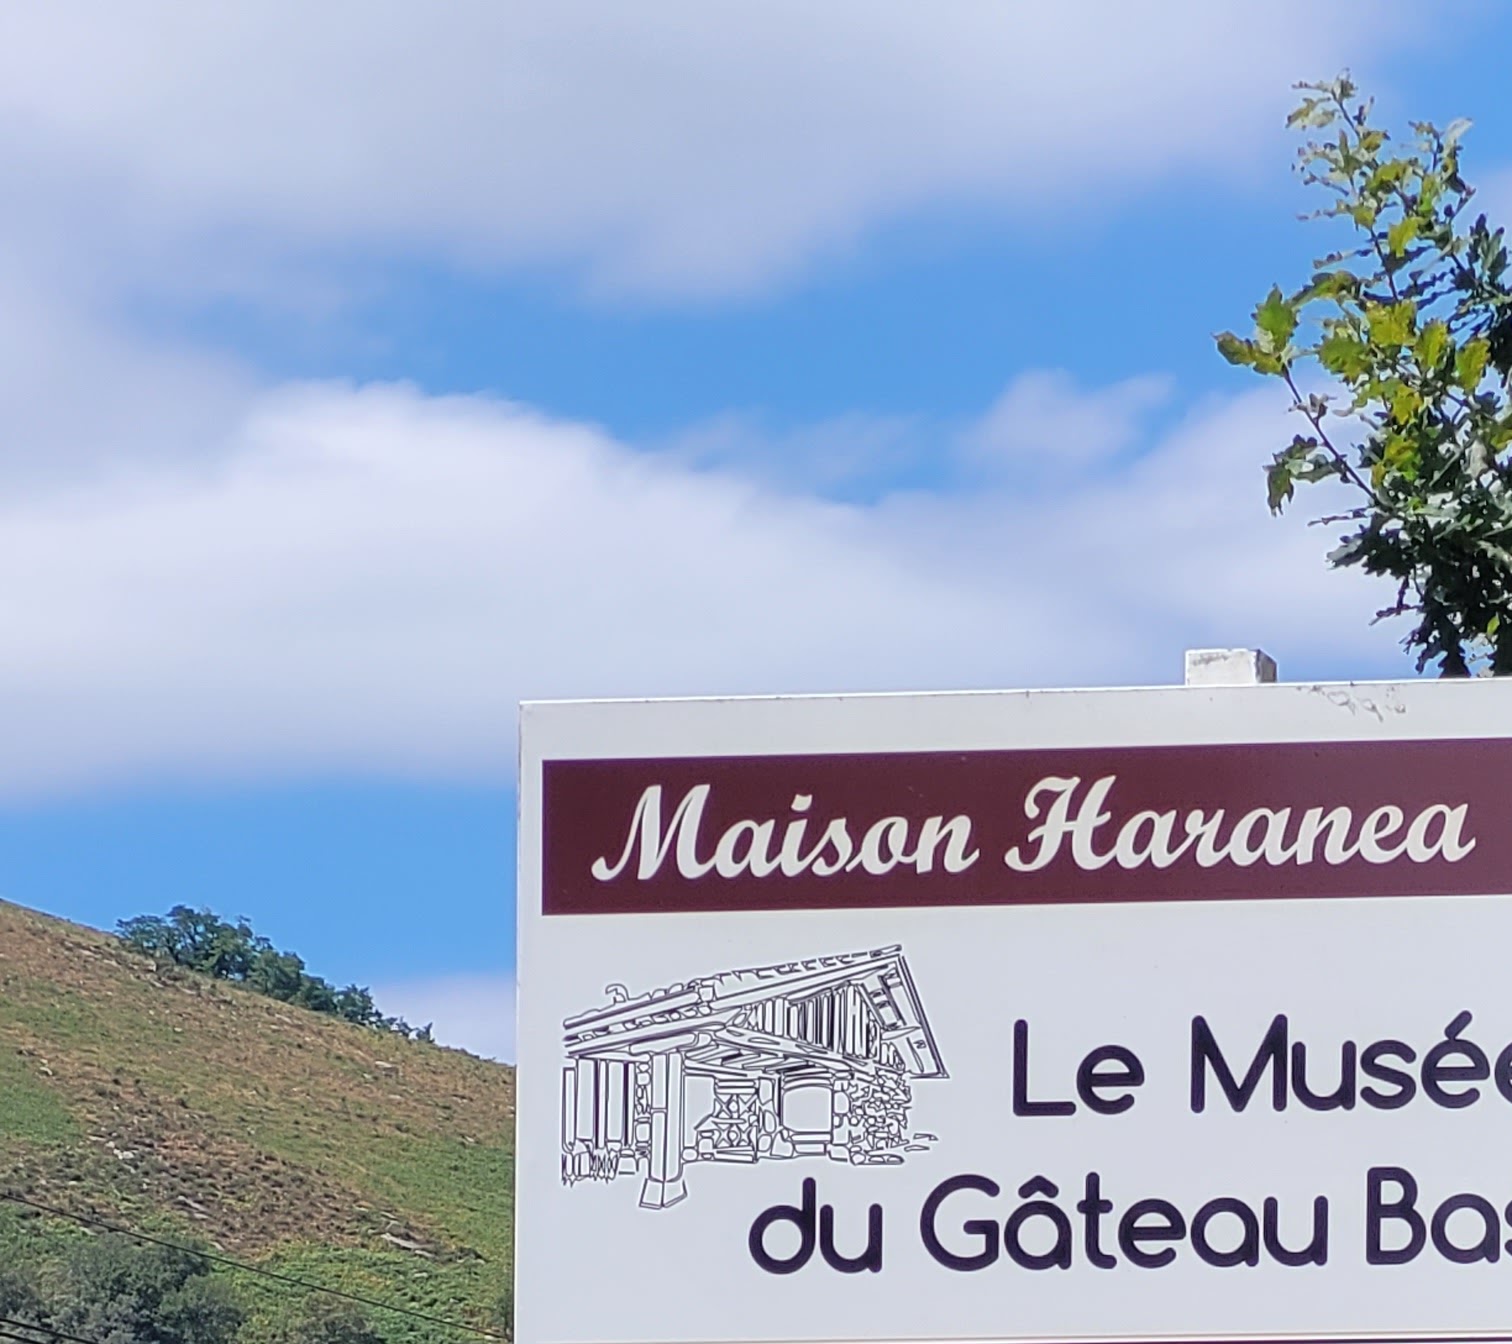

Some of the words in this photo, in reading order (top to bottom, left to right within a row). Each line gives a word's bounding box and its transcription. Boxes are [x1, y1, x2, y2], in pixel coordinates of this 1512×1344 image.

[592, 784, 979, 881] Maison
[1004, 775, 1476, 874] Haranea
[1012, 1019, 1145, 1117] Le
[748, 1177, 884, 1275] du
[920, 1171, 1329, 1272] Gâteau
